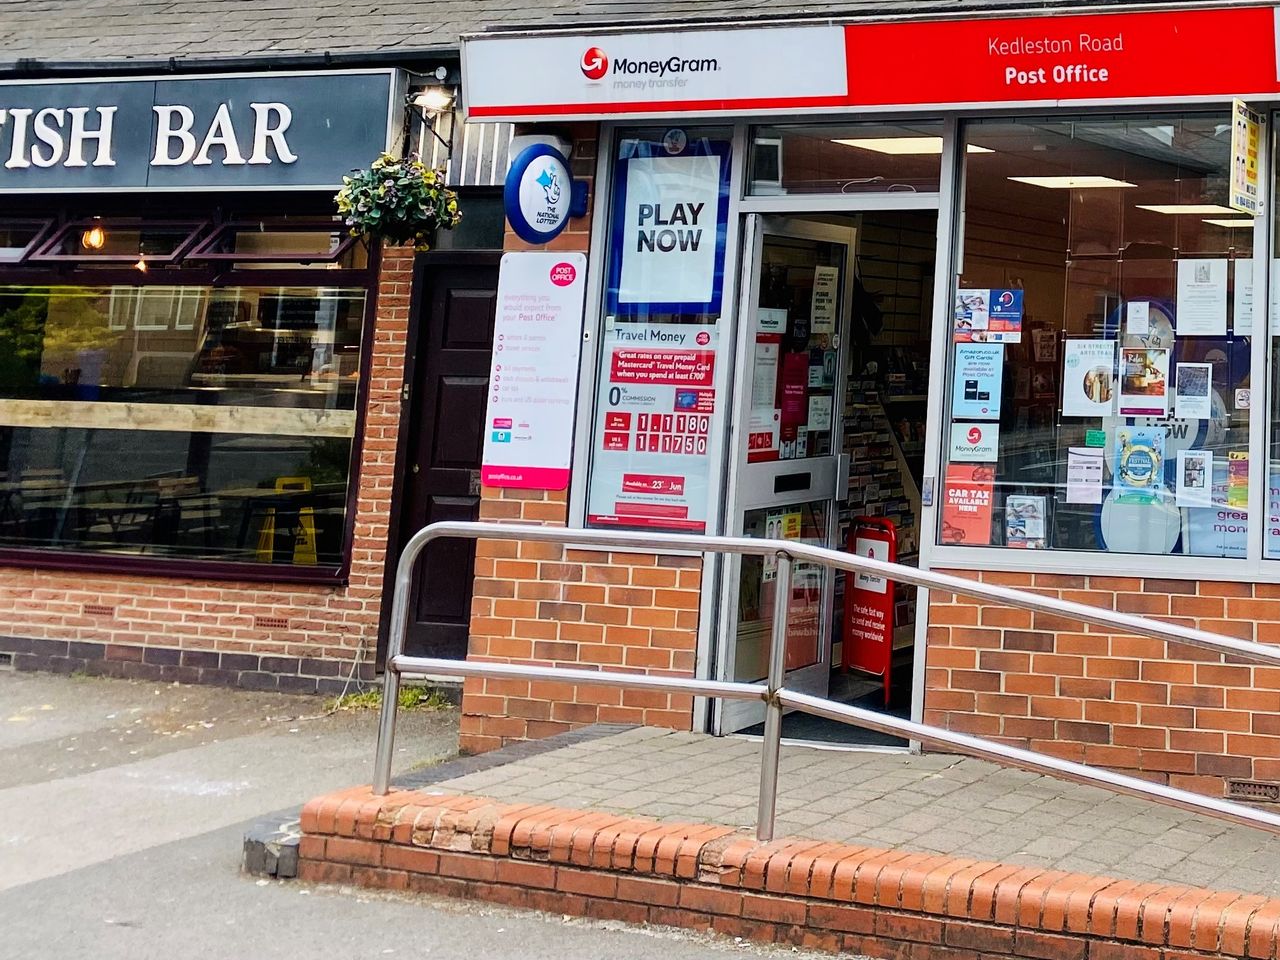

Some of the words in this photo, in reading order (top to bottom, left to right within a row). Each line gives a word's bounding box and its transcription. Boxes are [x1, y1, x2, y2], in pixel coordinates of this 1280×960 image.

[988, 36, 1072, 56] Kedleston
[1079, 33, 1123, 52] Road
[612, 56, 718, 77] MoneyGram
[1005, 66, 1046, 85] Post
[1053, 64, 1109, 83] Office
[613, 79, 646, 90] money
[648, 77, 688, 89] transfer
[0, 105, 118, 169] ISH
[150, 102, 298, 167] BAR
[638, 202, 705, 226] PLAY
[636, 228, 703, 252] NOW
[551, 273, 574, 281] OFFICE
[615, 328, 647, 341] Travel
[650, 330, 686, 344] Money
[618, 351, 637, 359] Great
[955, 445, 992, 453] MoneyGram
[948, 488, 968, 498] CAR
[970, 490, 989, 499] TAX
[948, 498, 989, 506] AVAILABLE
[1217, 511, 1248, 521] grea
